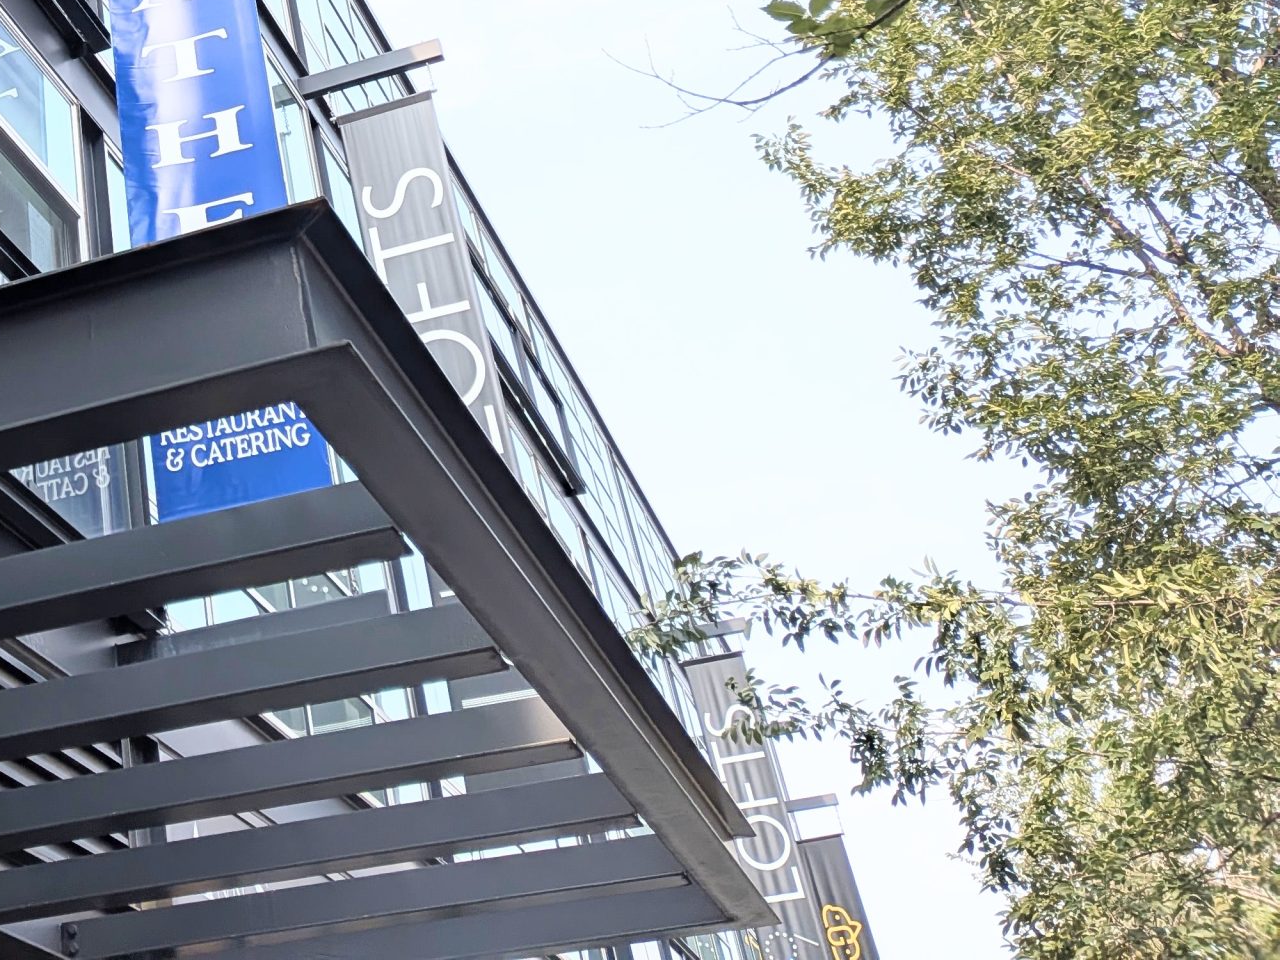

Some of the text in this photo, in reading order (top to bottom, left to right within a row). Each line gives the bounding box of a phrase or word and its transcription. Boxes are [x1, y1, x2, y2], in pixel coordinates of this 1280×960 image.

[160, 401, 306, 446] RESTAURAN
[166, 423, 311, 472] & CATERING
